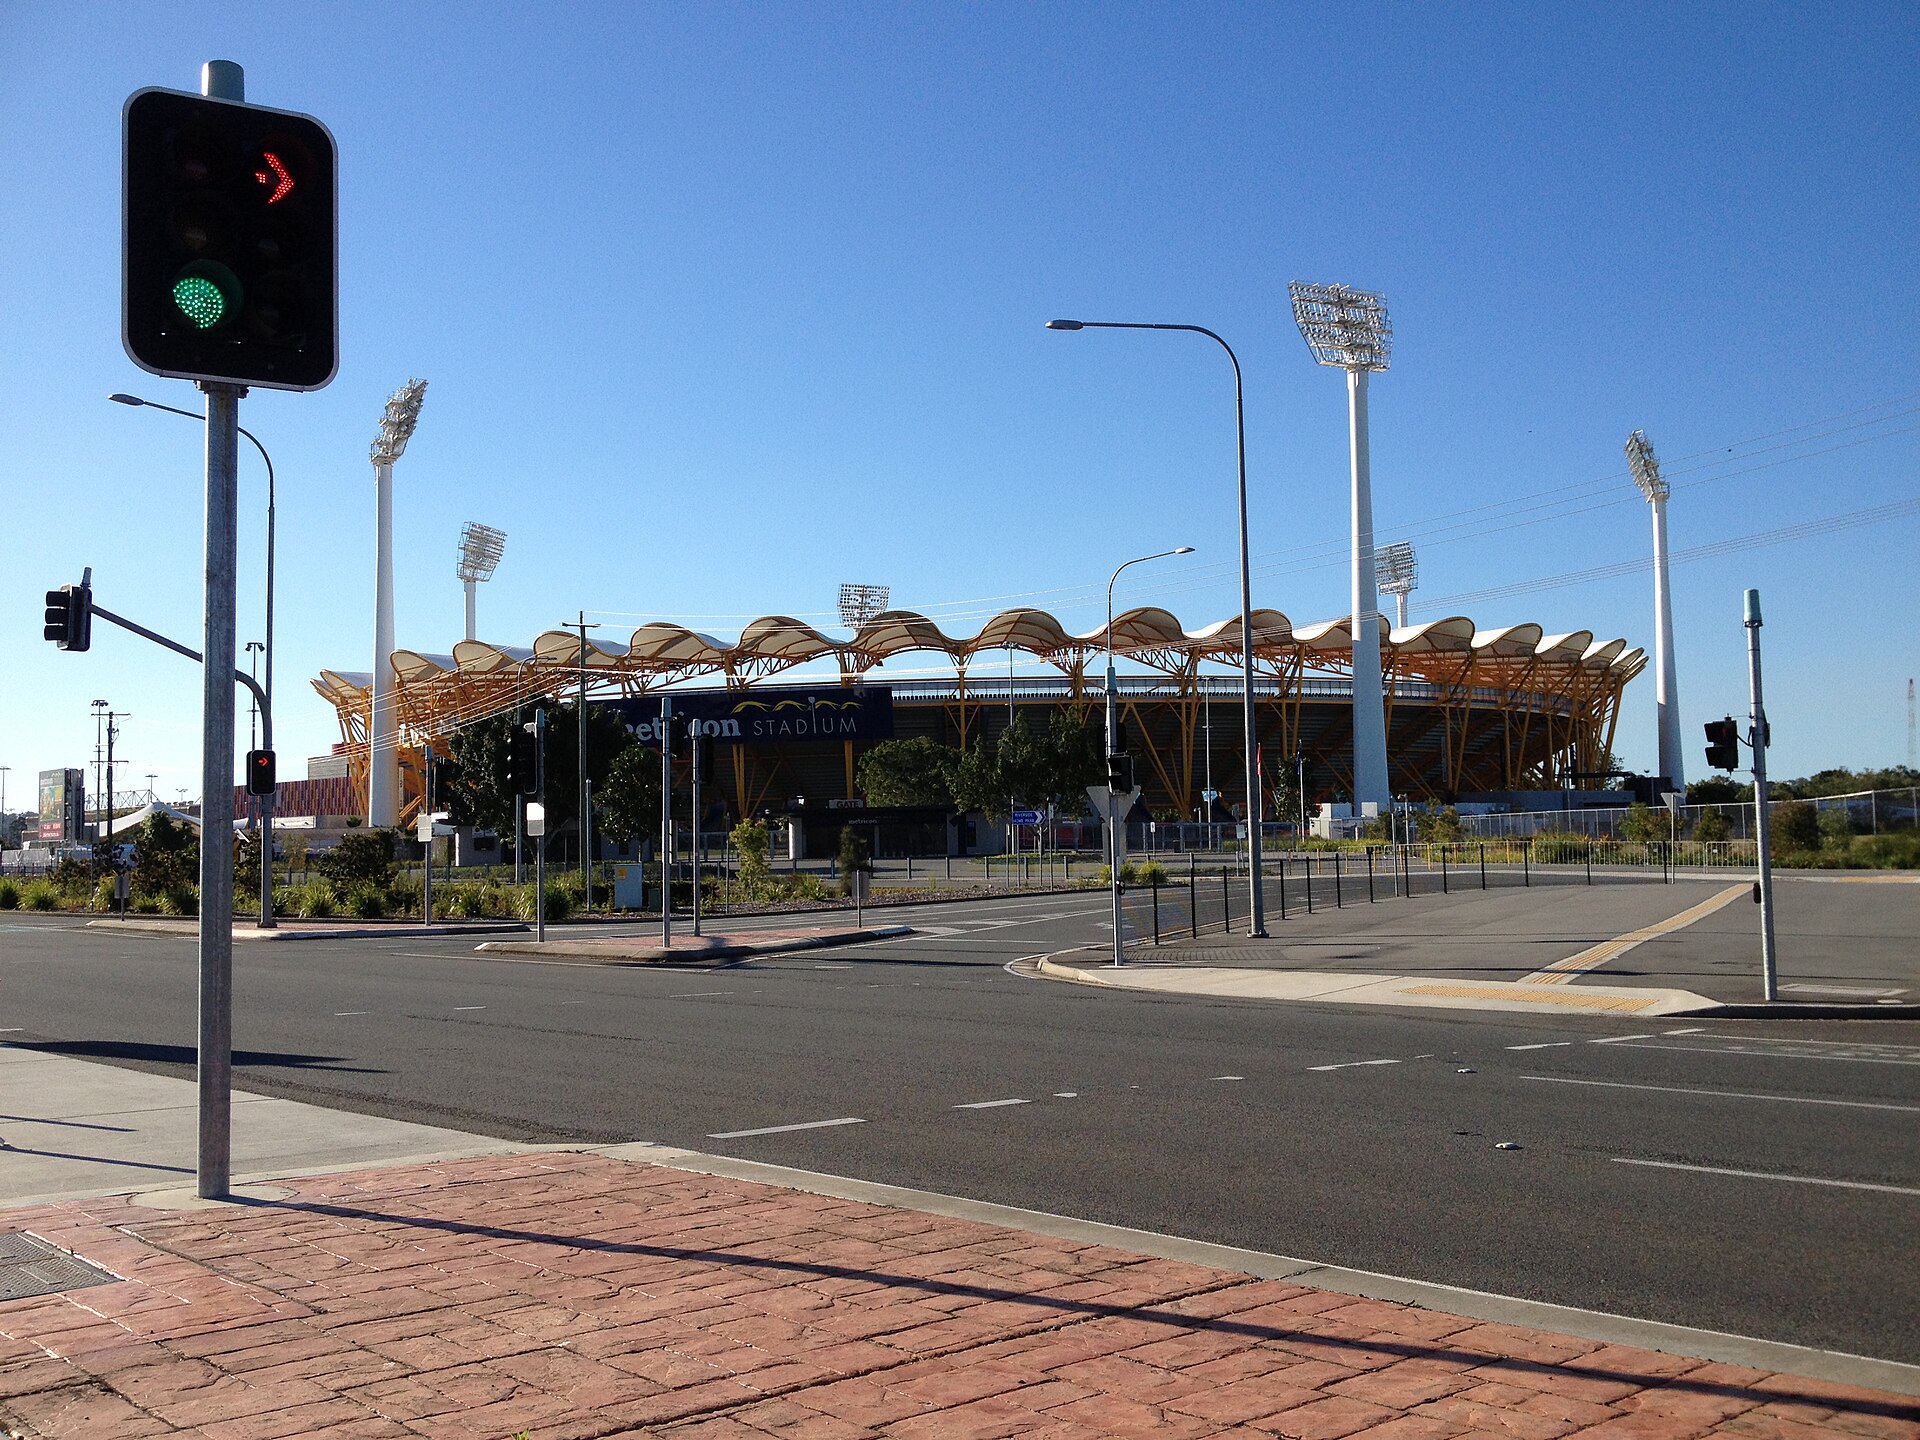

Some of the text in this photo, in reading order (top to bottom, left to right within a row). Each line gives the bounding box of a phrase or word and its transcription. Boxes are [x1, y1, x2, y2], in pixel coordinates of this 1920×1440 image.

[625, 696, 857, 741] eton STADIUM
[837, 800, 859, 808] GATE
